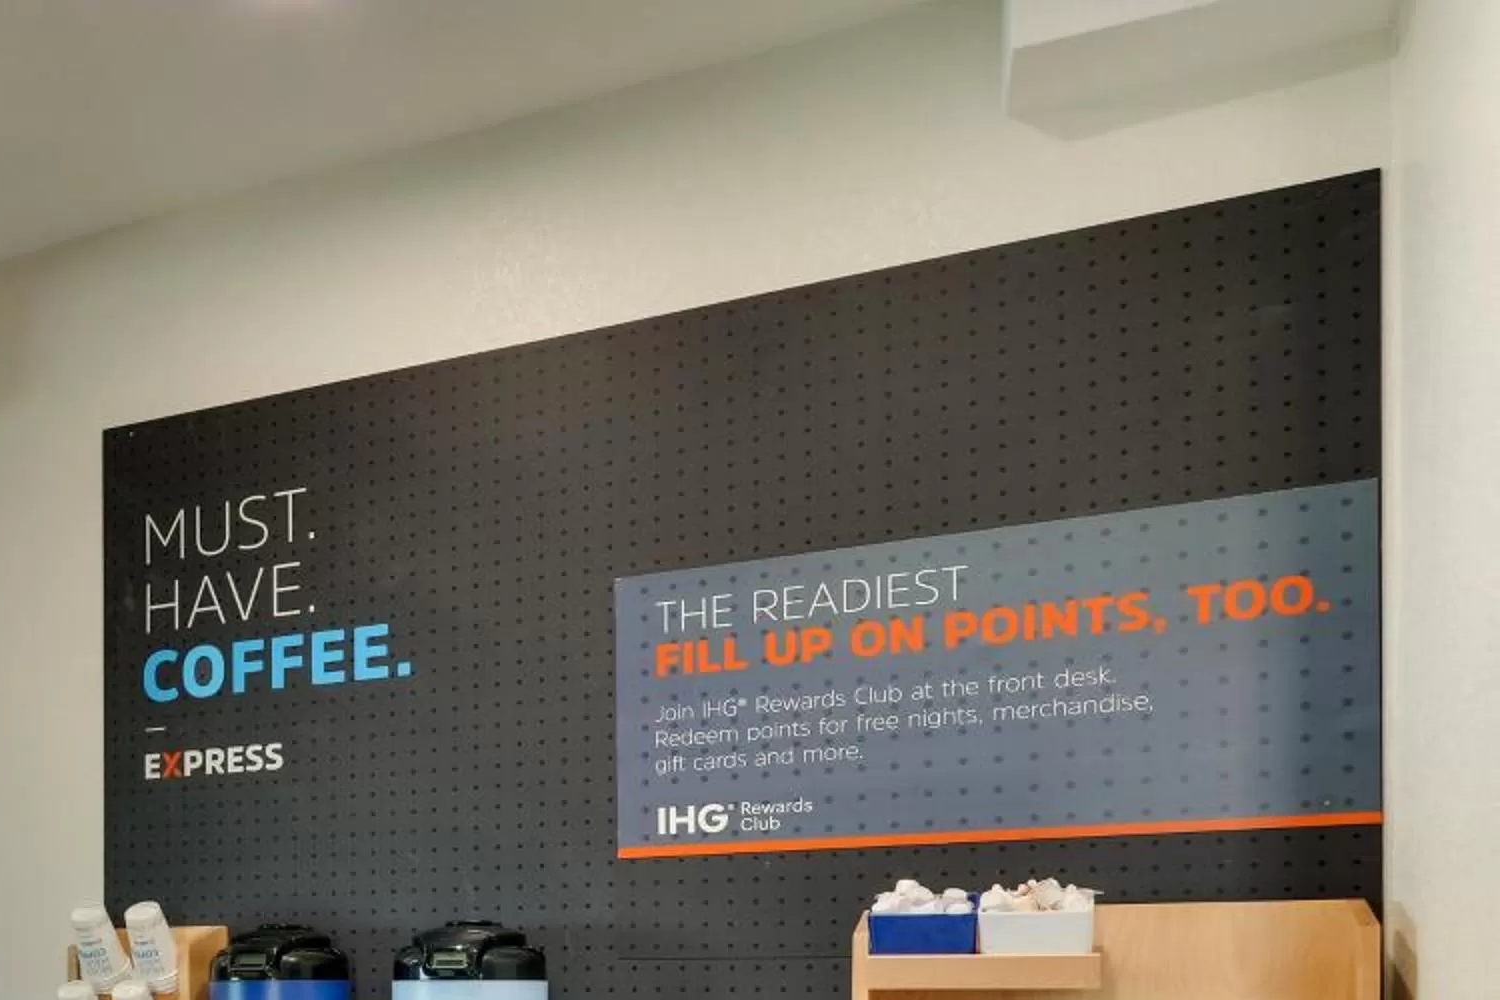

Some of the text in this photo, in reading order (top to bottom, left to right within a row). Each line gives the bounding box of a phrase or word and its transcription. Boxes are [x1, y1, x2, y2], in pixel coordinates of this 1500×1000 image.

[145, 487, 315, 566] MUST.
[145, 561, 315, 634] HAVE.
[654, 565, 969, 635] THE READIEST
[654, 574, 1332, 679] FILL UP ON POINTS, TOO.
[142, 623, 412, 703] COFFEE.
[654, 703, 696, 723] Join
[754, 689, 847, 713] Rewards
[853, 684, 903, 706] Club
[911, 681, 934, 701] at
[941, 679, 980, 698] the
[987, 671, 1045, 694] front
[1053, 665, 1117, 689] desk.
[654, 692, 1154, 749] Redeem points for free nights, merchandise,
[144, 743, 285, 780] EXPRESS
[654, 744, 864, 777] gift cards and more.
[740, 796, 814, 816] Rewards
[740, 815, 781, 832] Club
